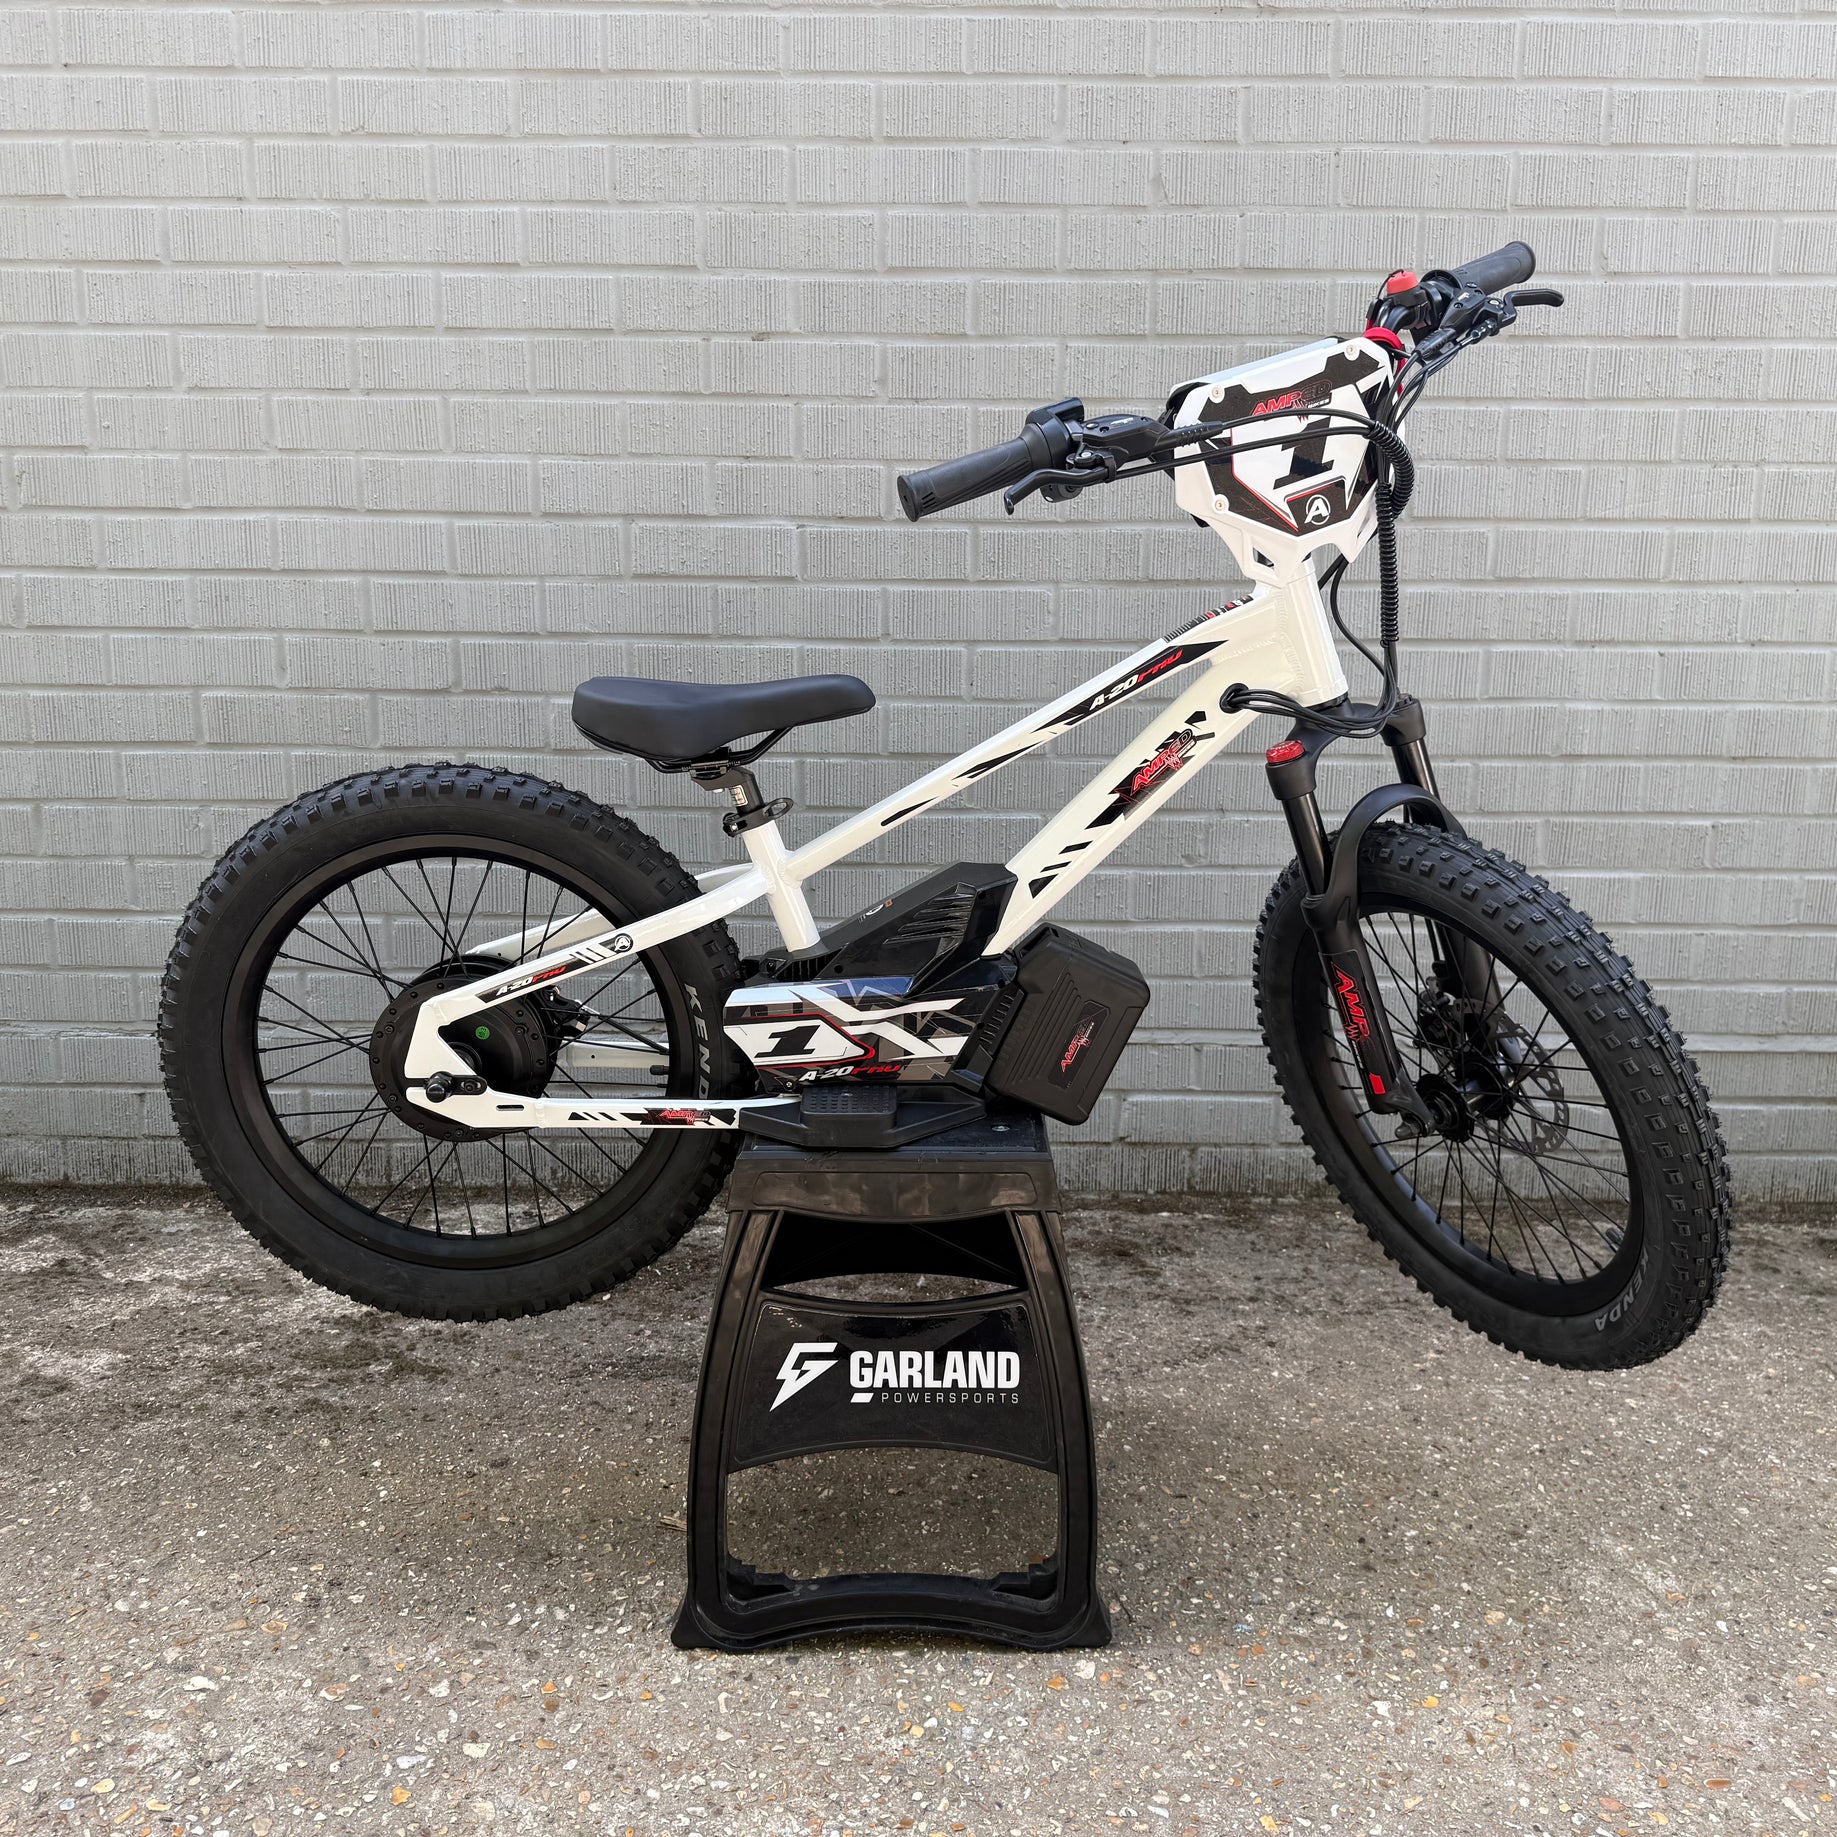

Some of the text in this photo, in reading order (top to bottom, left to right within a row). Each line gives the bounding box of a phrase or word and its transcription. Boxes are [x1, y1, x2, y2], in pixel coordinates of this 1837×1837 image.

[684, 984, 710, 1099] KEND
[754, 1025, 821, 1058] 1
[1595, 1246, 1648, 1331] KENDA
[850, 1351, 1020, 1388] GARLAND
[881, 1392, 1019, 1404] POWERSPORTS
